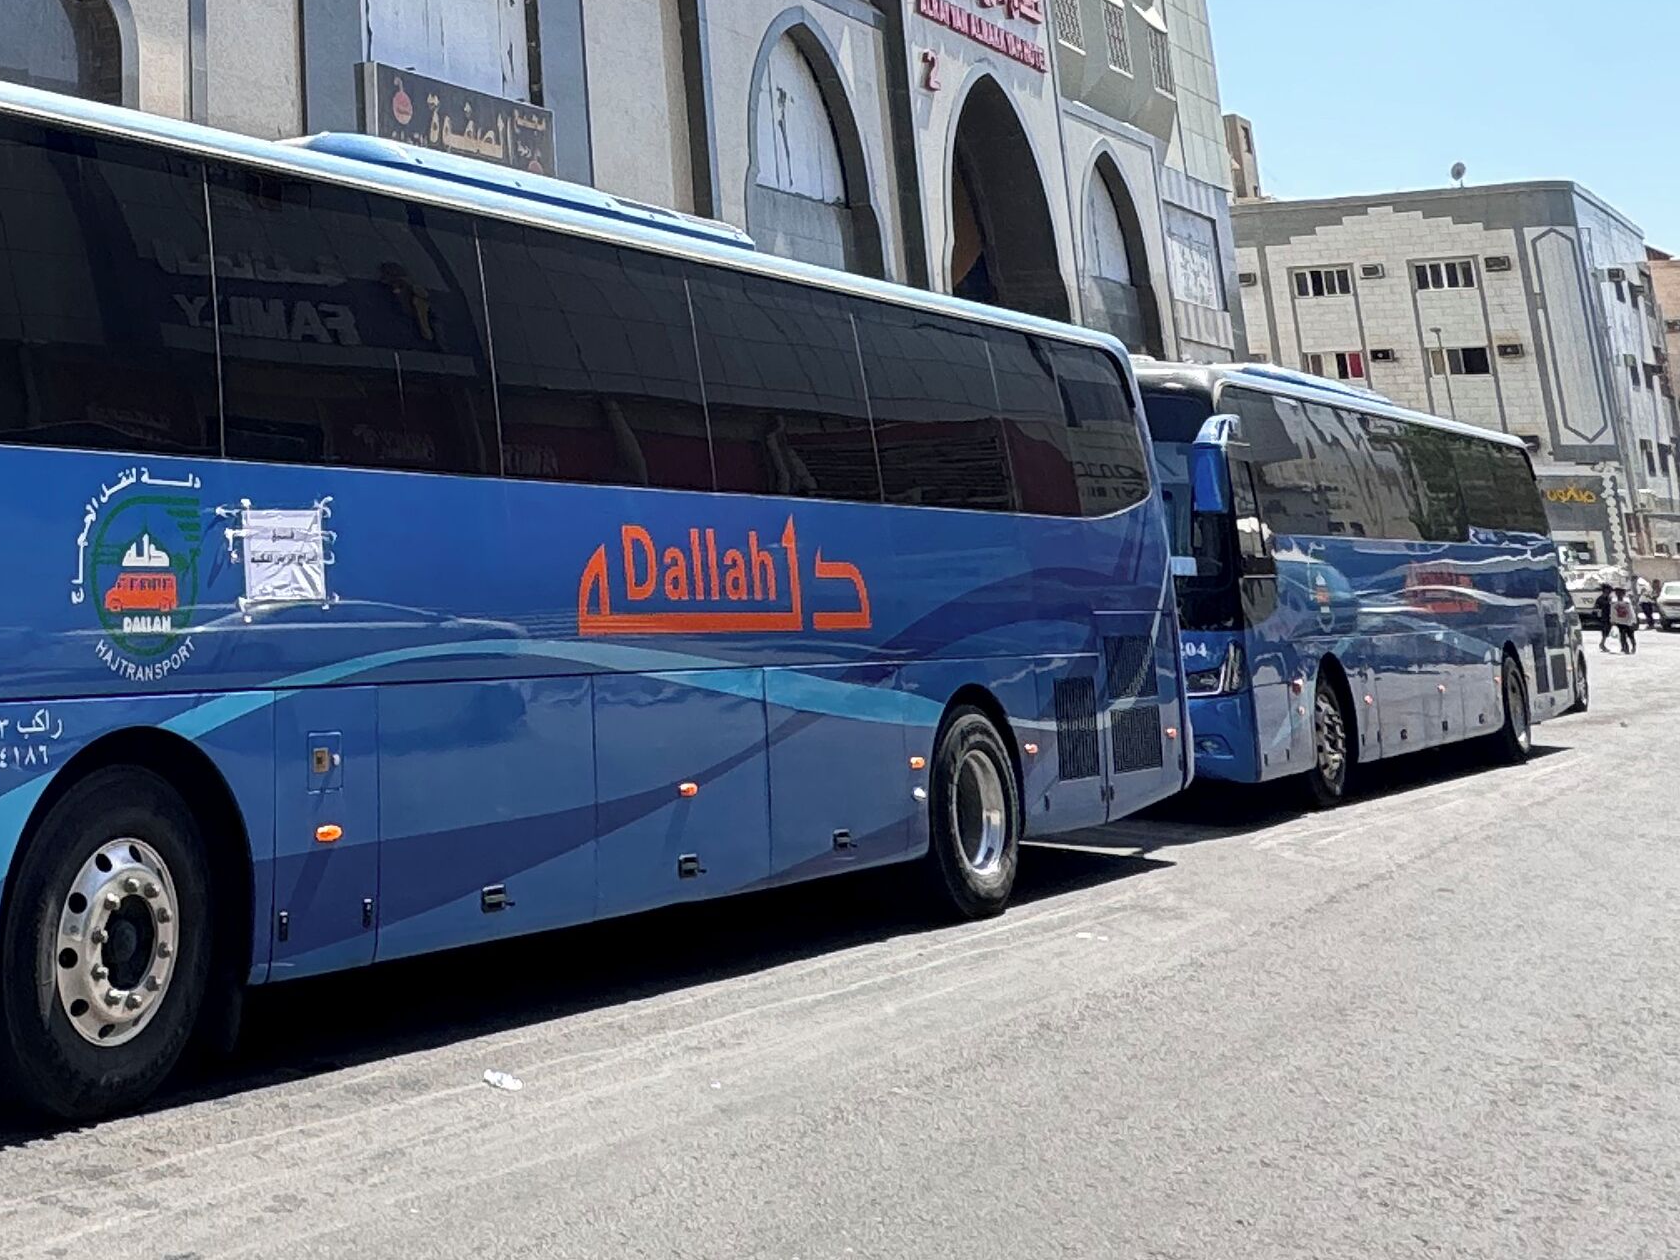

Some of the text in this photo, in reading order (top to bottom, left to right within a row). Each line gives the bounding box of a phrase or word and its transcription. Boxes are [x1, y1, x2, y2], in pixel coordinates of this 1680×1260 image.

[621, 524, 777, 601] Dallah
[16, 707, 64, 740] راكب
[0, 744, 49, 769] ٤١٨٦
